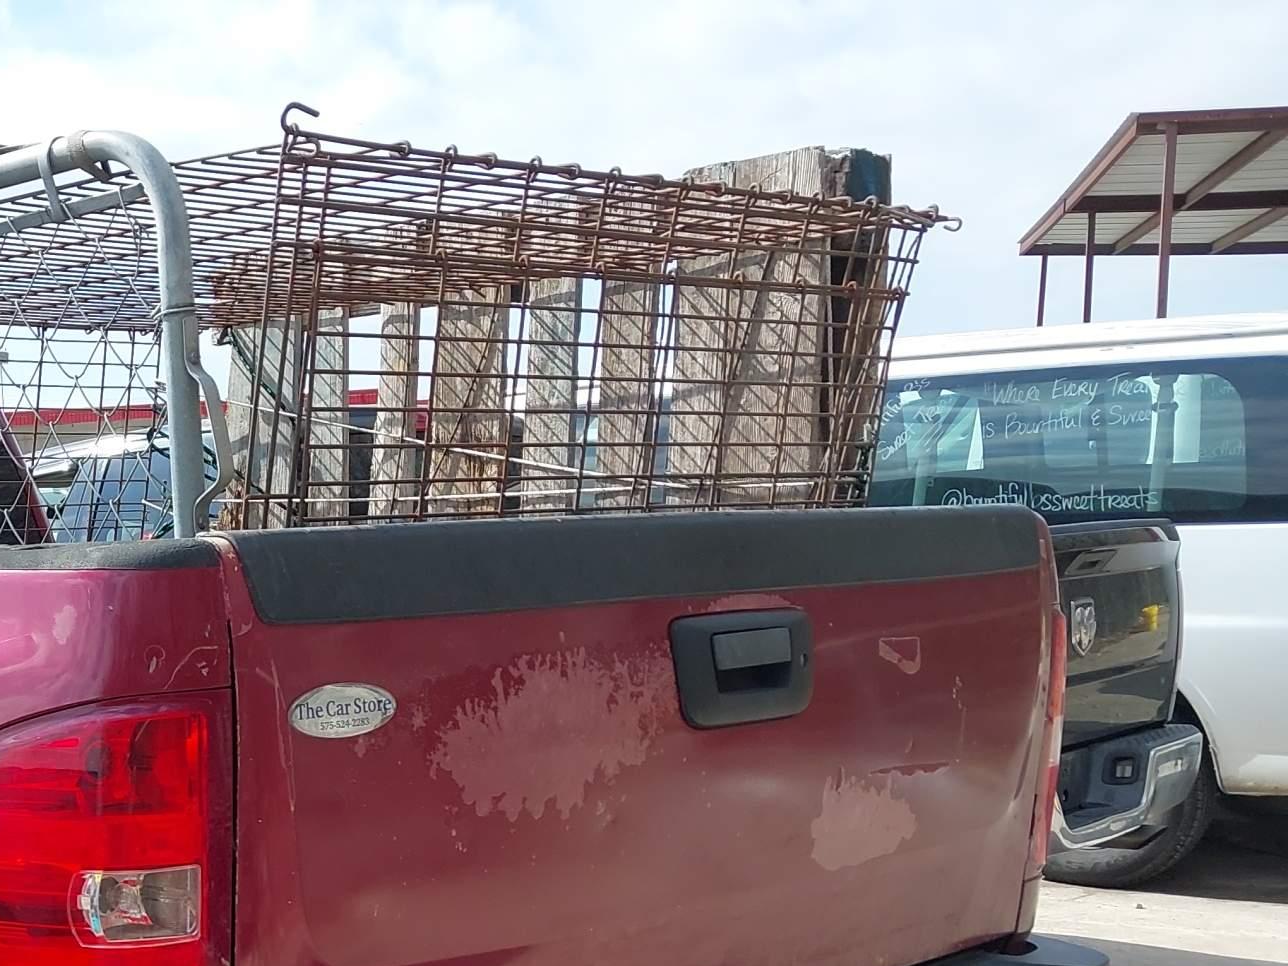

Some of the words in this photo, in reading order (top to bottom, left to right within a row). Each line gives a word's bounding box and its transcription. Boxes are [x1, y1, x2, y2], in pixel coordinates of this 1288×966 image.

[1004, 407, 1083, 440] Bountiful
[297, 703, 324, 721] The
[326, 700, 352, 718] Car
[353, 697, 393, 714] Store
[320, 717, 370, 731] 575-524-2283
